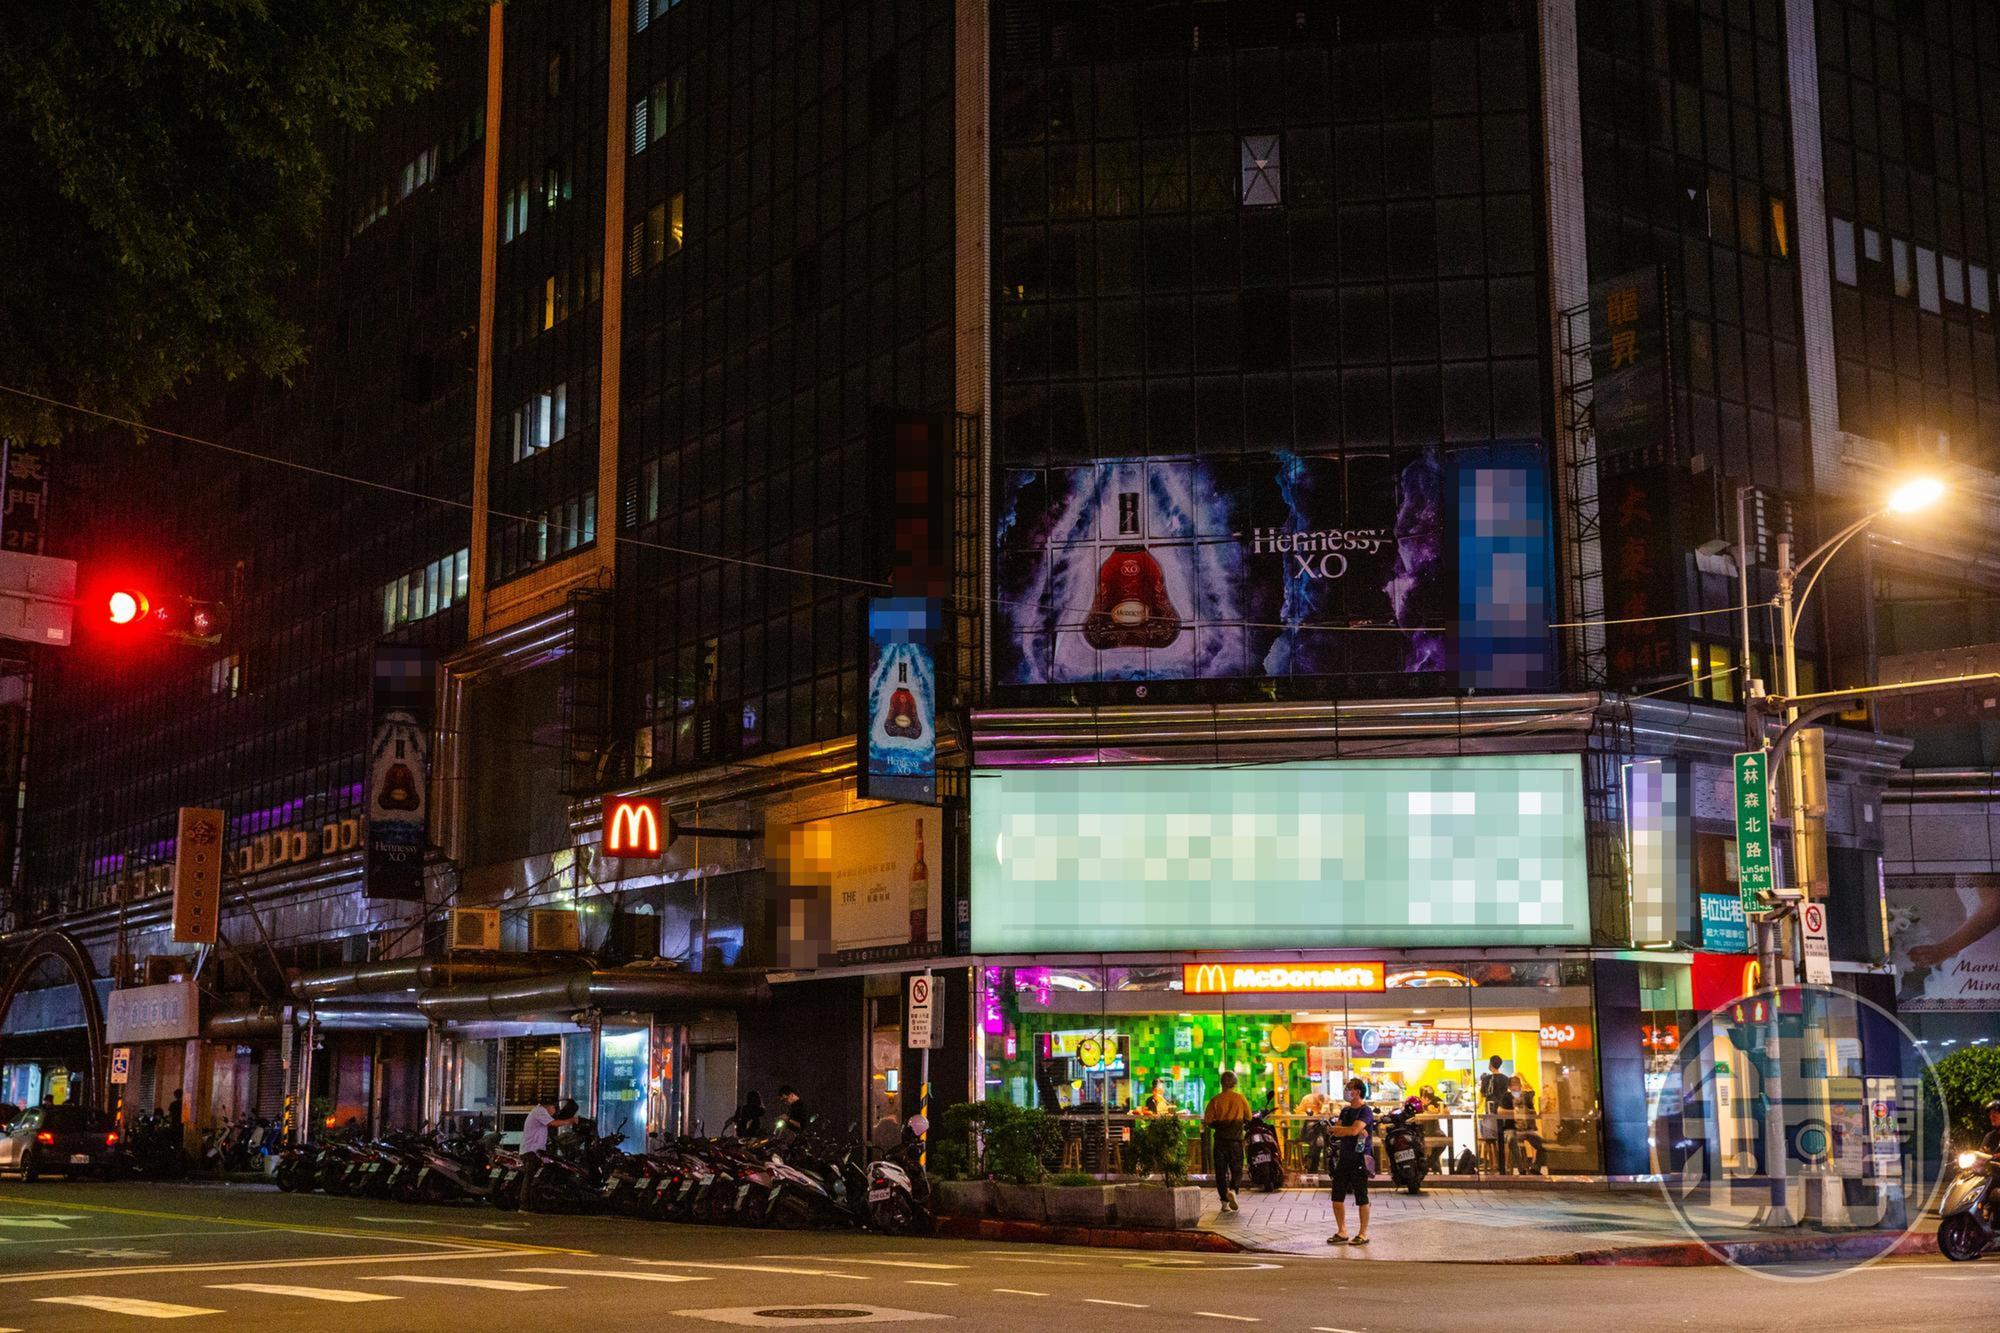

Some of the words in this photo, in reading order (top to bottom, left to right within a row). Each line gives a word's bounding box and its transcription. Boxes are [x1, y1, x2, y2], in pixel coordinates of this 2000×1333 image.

[1253, 527, 1386, 554] Hennessy
[1743, 768, 1761, 857] 林森北路
[1741, 865, 1770, 873] LinSen
[1233, 968, 1374, 987] McDonald's
